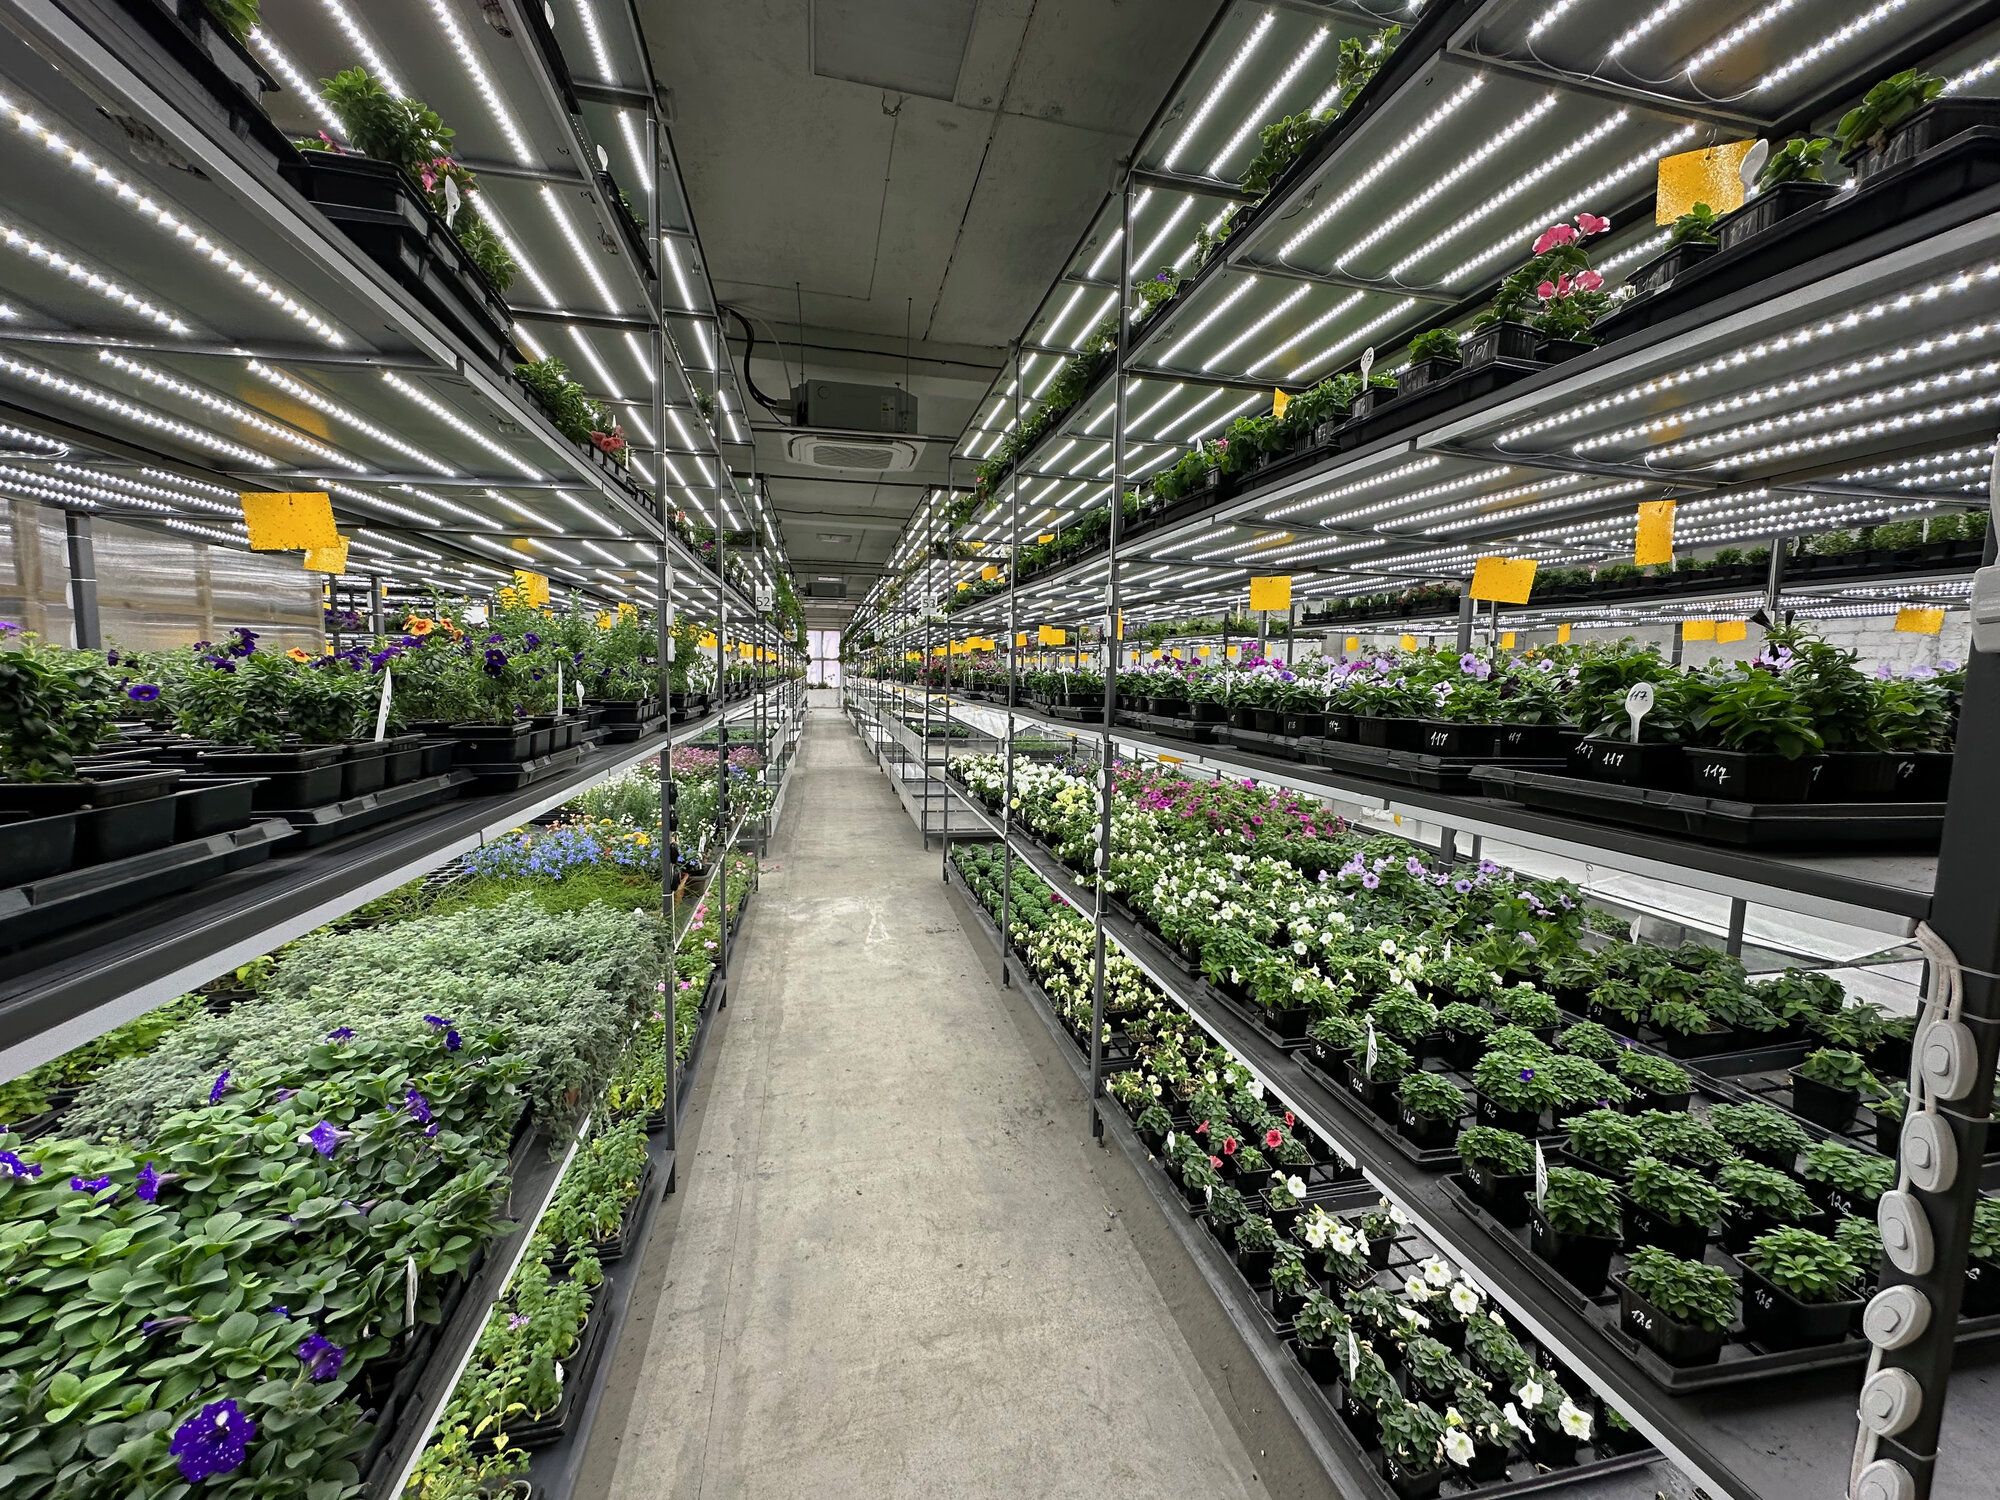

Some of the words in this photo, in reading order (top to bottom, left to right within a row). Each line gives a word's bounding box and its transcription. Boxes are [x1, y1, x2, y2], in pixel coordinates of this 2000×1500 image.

[757, 597, 770, 606] 52
[923, 599, 935, 608] 53
[1431, 732, 1448, 746] 117
[1508, 732, 1522, 744] 117
[1575, 742, 1594, 759] 117
[1603, 753, 1624, 767] 117
[1703, 764, 1731, 784] 117
[1484, 1102, 1497, 1119] 126
[1468, 1168, 1481, 1185] 126
[1827, 1191, 1852, 1214] 126
[1755, 1289, 1773, 1310] 126
[1631, 1309, 1652, 1330] 126
